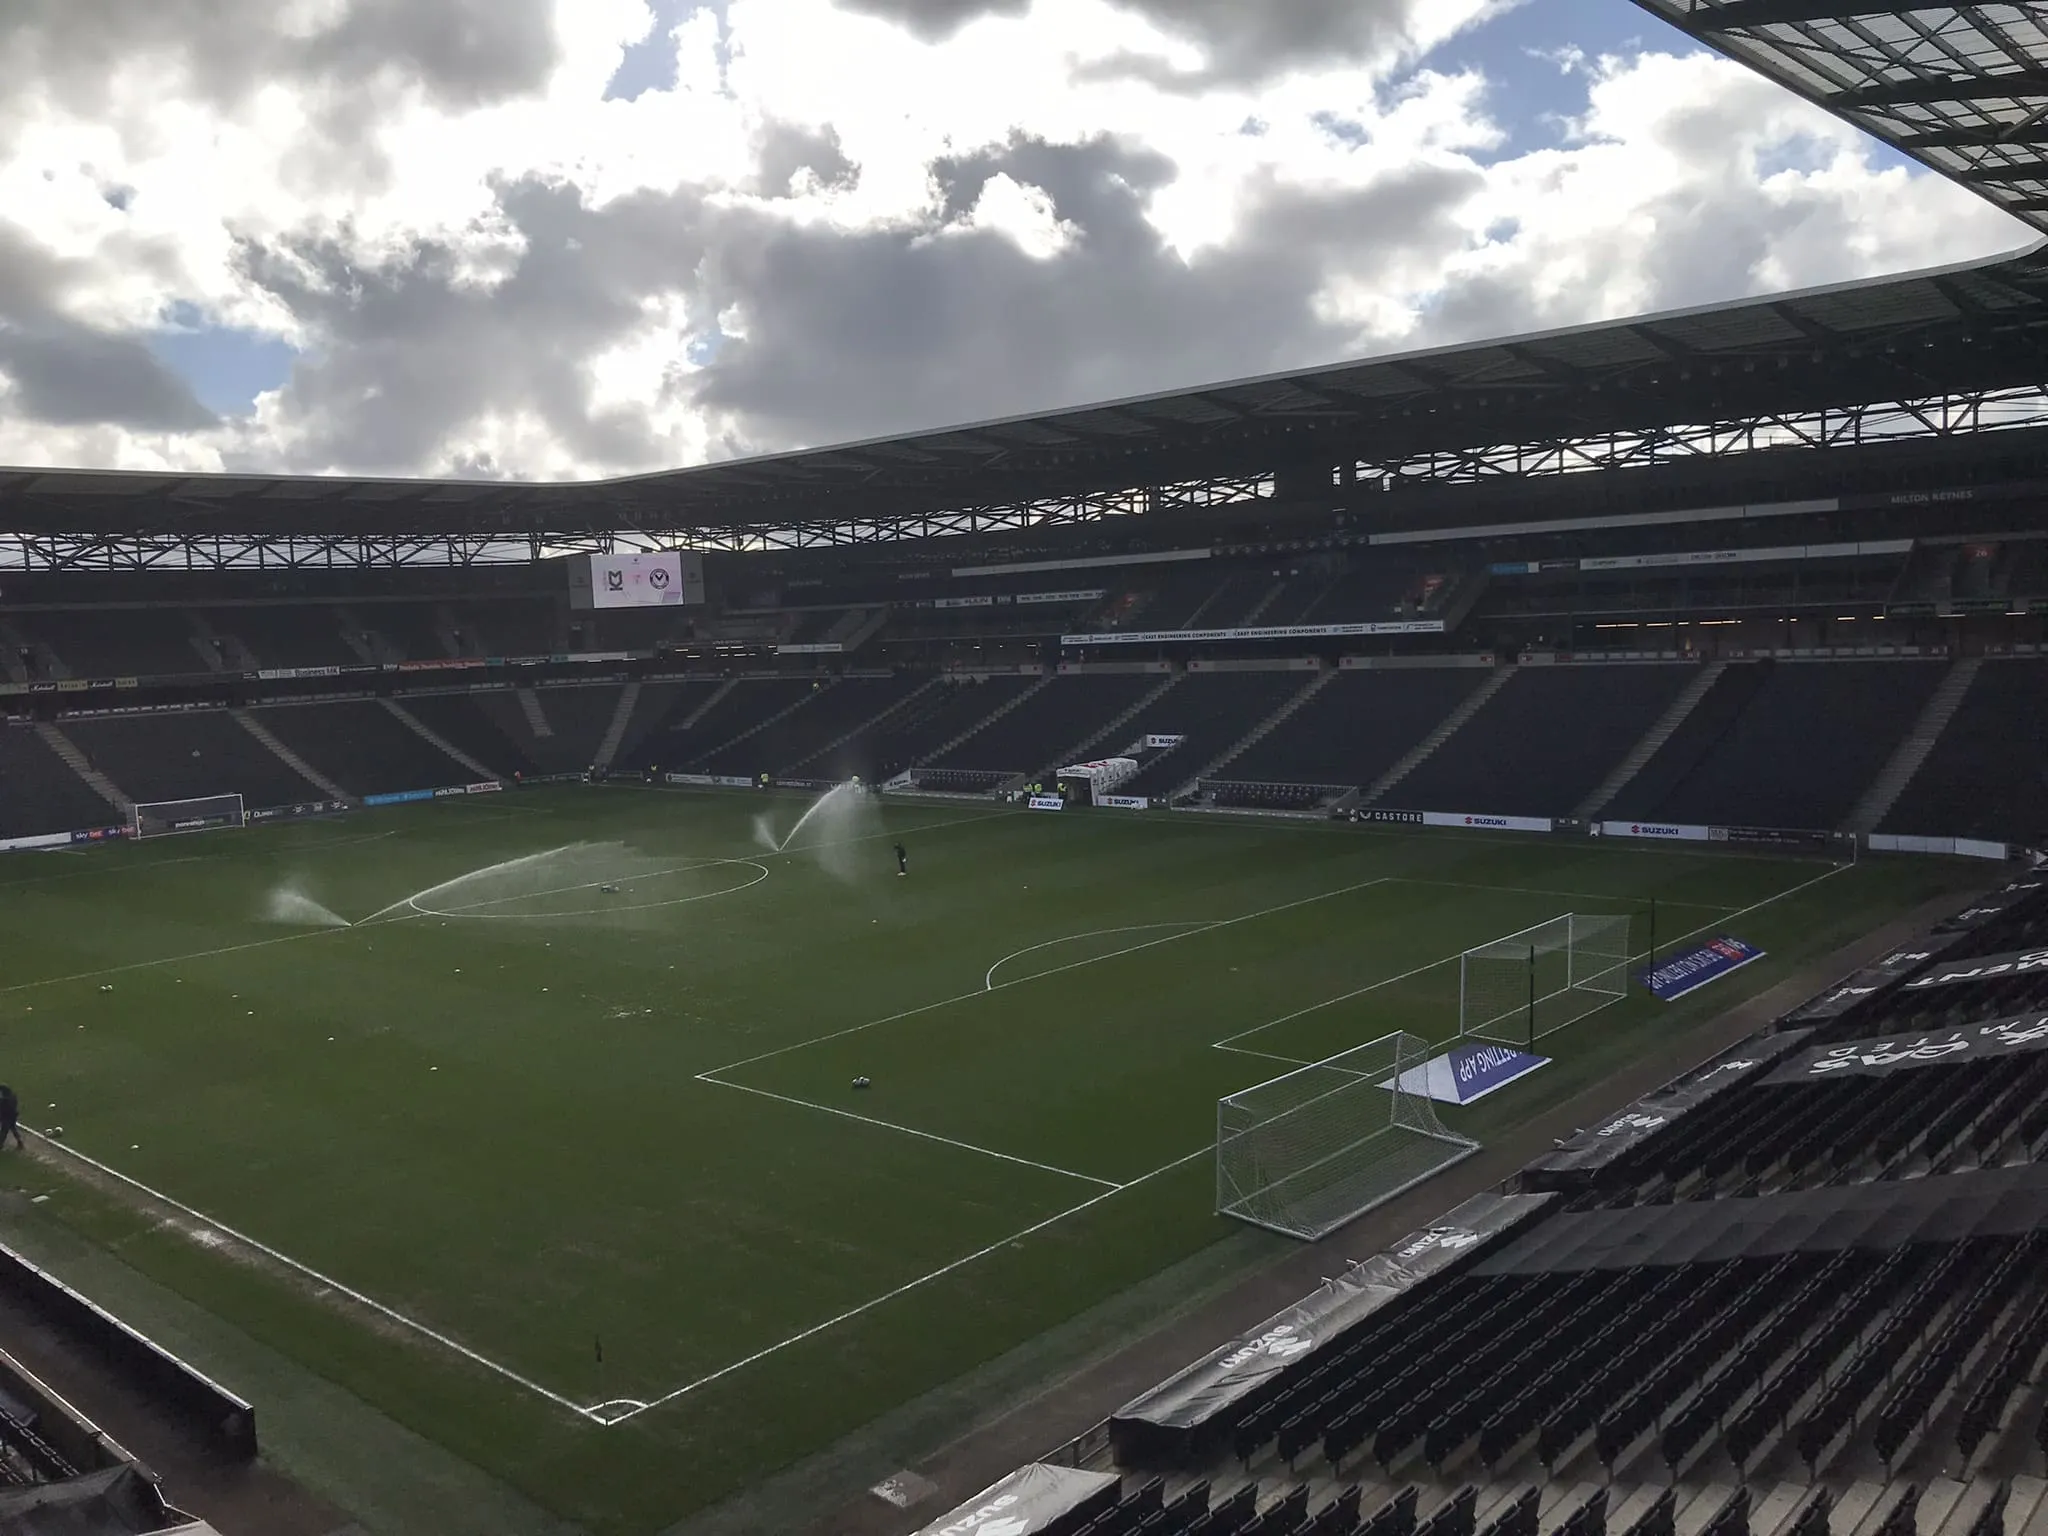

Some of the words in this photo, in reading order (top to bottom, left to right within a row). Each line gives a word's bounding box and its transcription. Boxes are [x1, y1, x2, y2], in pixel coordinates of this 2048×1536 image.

[1890, 493, 1929, 504] MILTON
[1931, 490, 1973, 501] KEYNES
[1251, 628, 1287, 636] ENGINEERING
[1288, 627, 1327, 635] COMPONENTS
[1037, 800, 1061, 808] SUZUKI
[1375, 811, 1422, 823] CASTORE
[1474, 818, 1506, 826] SUZUKI
[1641, 826, 1679, 835] SUZUKI
[1808, 1040, 1969, 1074] GAS
[1459, 1056, 1478, 1082] APP
[1218, 1325, 1294, 1369] SUZUKI
[930, 1494, 1019, 1536] SUZU
